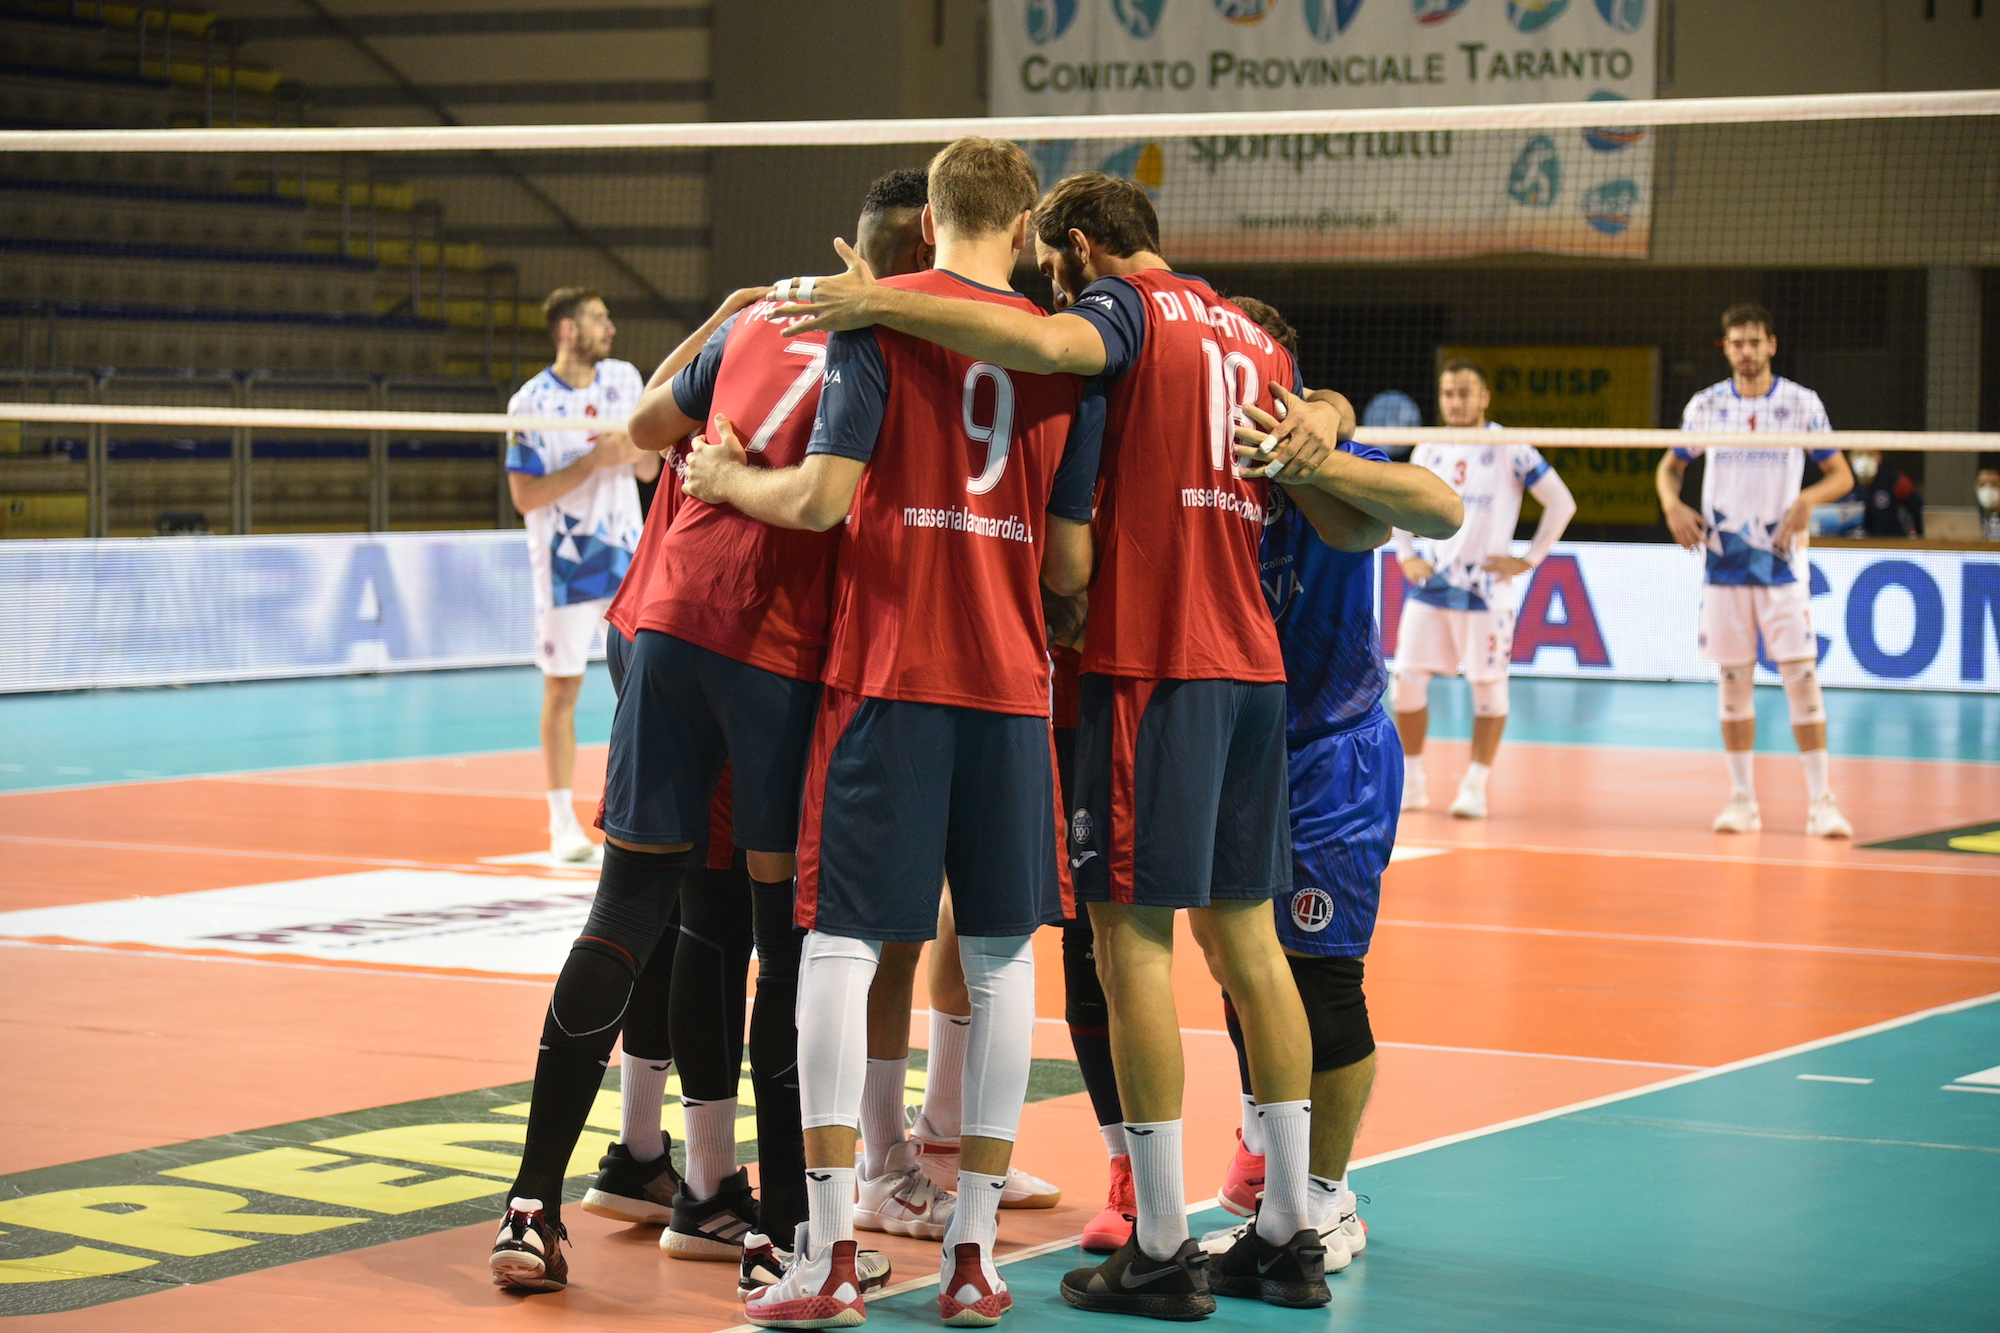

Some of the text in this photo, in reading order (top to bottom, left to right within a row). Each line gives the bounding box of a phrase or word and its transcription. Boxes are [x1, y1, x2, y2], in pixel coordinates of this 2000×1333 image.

[1152, 290, 1188, 321] DI
[738, 340, 827, 454] 7
[961, 360, 1016, 496] 9
[1201, 338, 1259, 480] 18
[1454, 460, 1467, 486] 3
